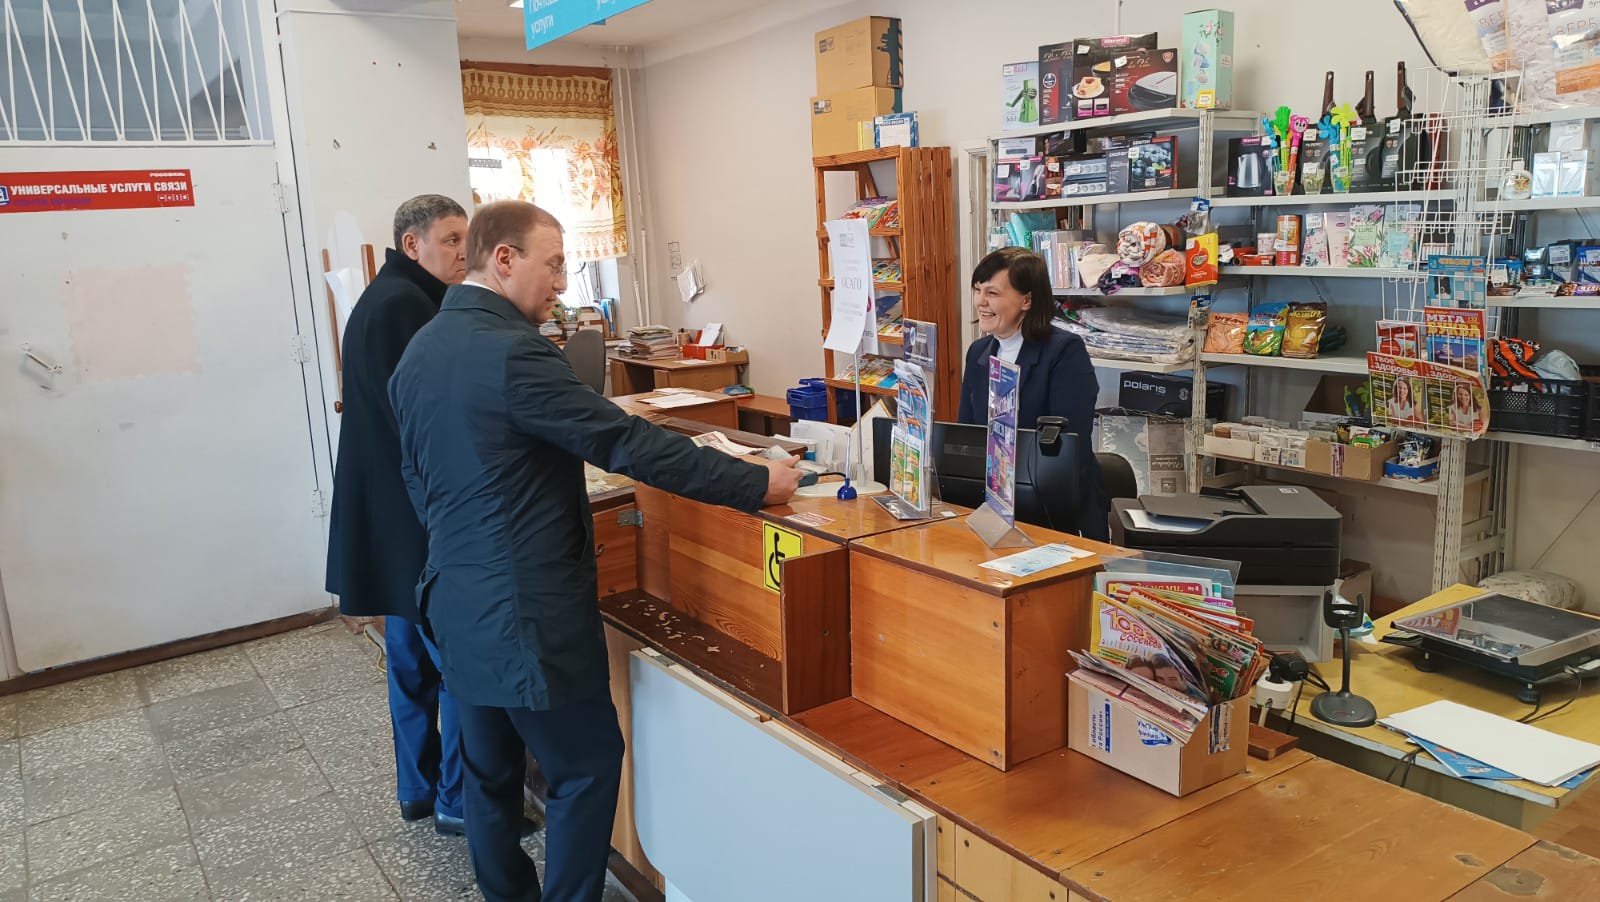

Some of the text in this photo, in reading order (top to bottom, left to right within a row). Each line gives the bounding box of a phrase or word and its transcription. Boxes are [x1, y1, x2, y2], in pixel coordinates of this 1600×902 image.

[10, 181, 187, 195] УНИВЕРСАЛЬНЫЕ УСЛУГИ СВЯЗИ
[1426, 313, 1465, 324] МЕГА
[1123, 380, 1167, 394] polaris
